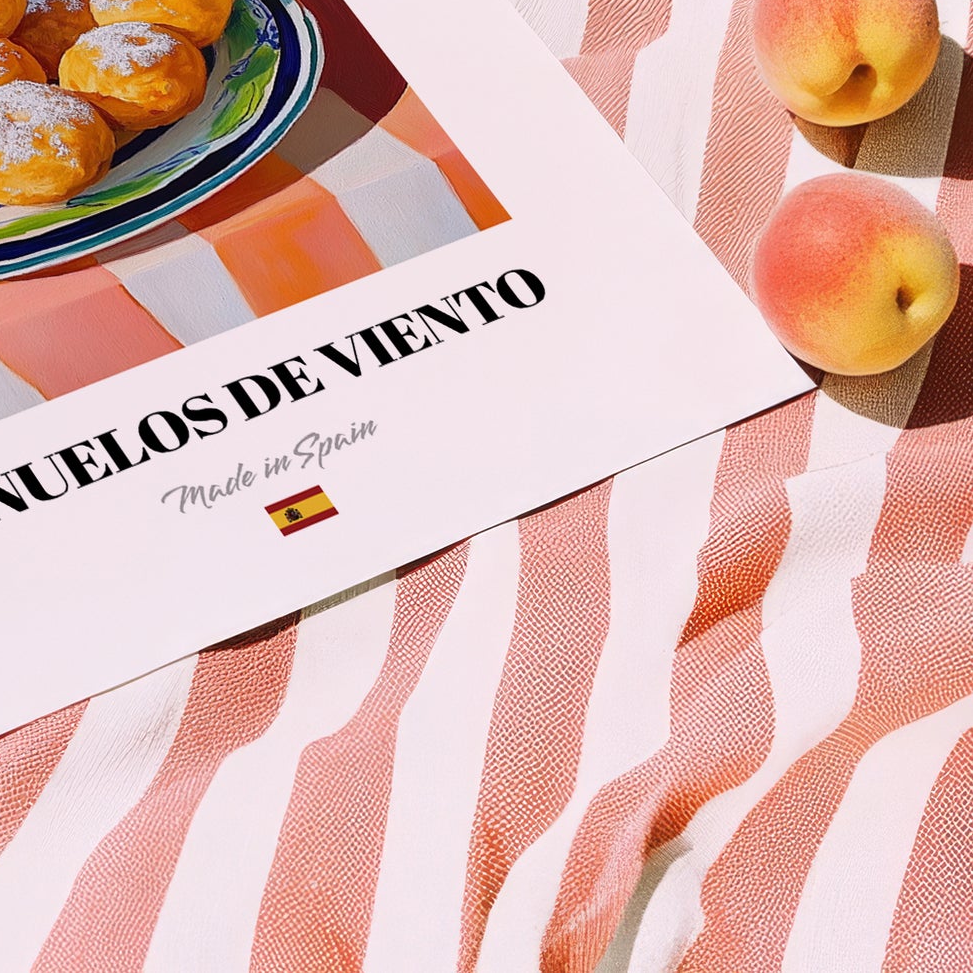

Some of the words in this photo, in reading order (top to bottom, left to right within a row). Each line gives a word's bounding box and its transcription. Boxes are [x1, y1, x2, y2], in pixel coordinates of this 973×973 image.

[221, 355, 326, 422] DE
[313, 269, 546, 377] VIENTO
[161, 463, 258, 514] Made
[264, 455, 292, 479] in
[293, 420, 378, 470] Spain
